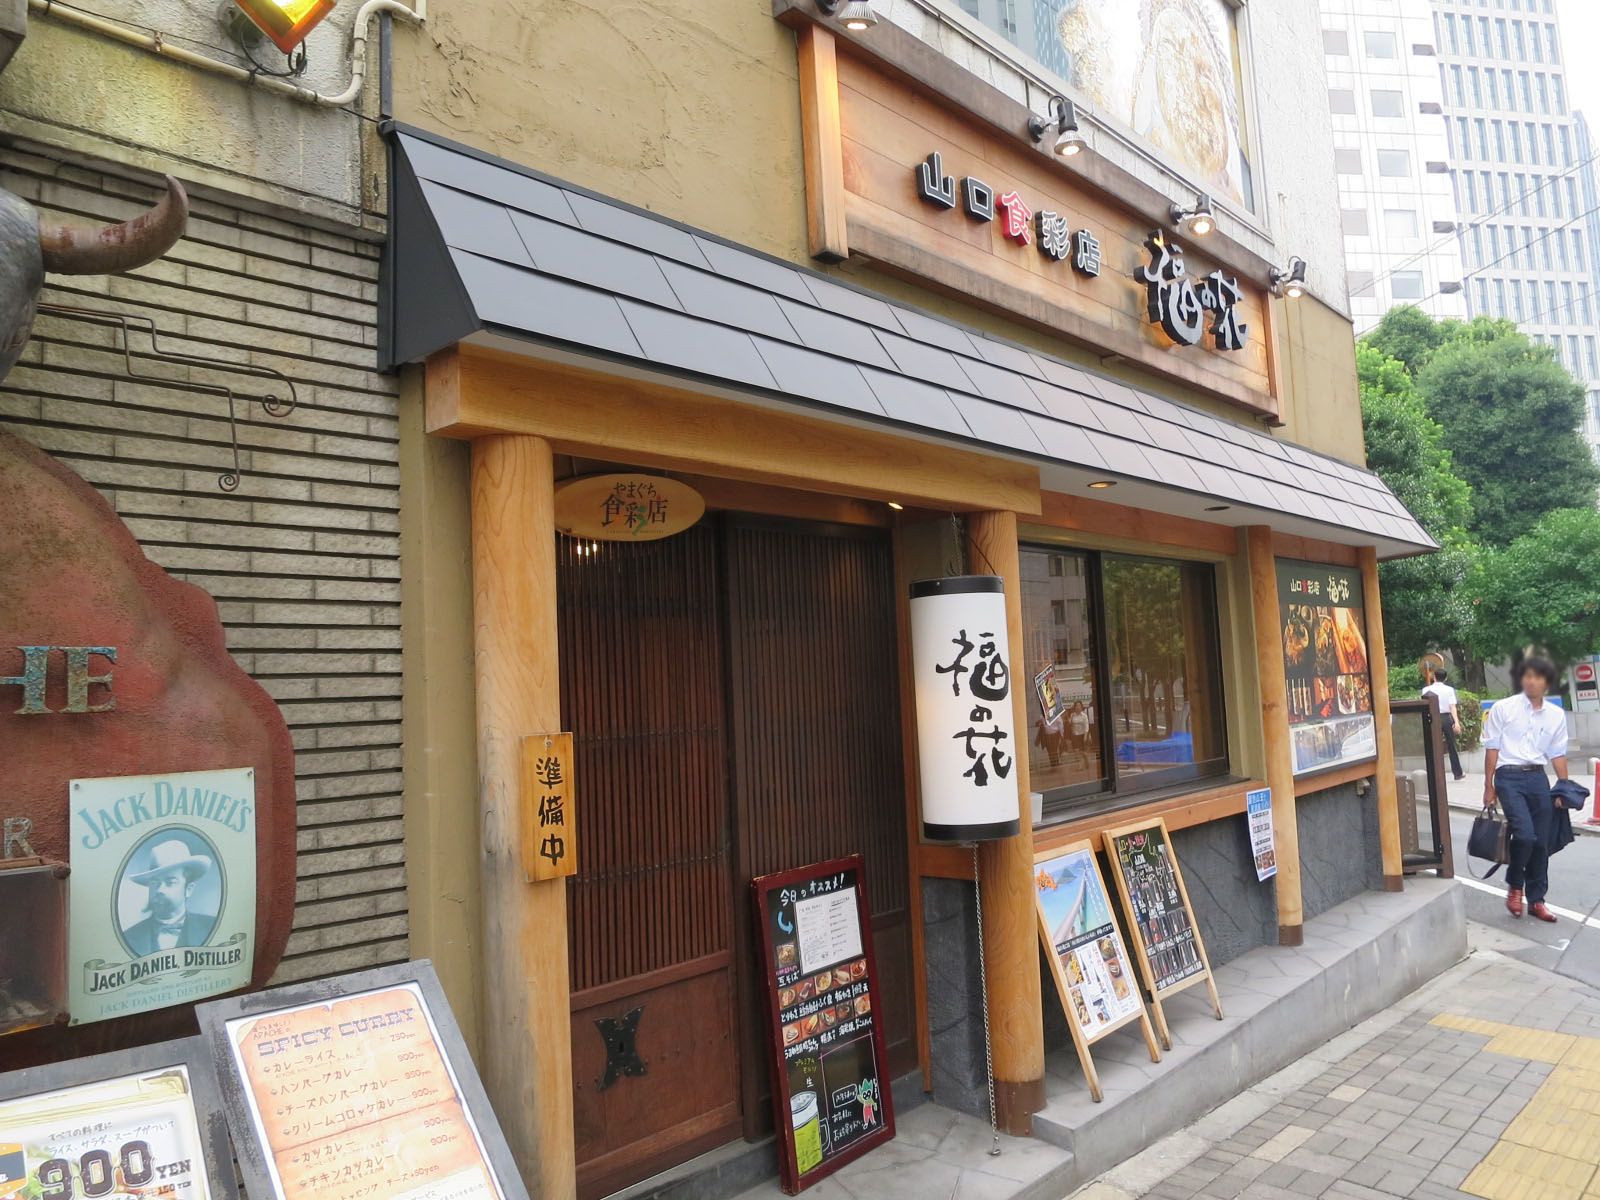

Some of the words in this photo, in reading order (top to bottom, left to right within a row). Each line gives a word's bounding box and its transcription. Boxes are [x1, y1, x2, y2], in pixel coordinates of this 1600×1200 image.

[916, 151, 1102, 277] 山口食彩店
[613, 481, 657, 499] やまぐち
[600, 494, 668, 528] 食彩店
[77, 792, 151, 849] JACK
[154, 781, 252, 832] DANIEL'S
[535, 756, 565, 867] 準備中
[90, 970, 126, 992] JACK
[184, 948, 242, 967] DISTILLER
[257, 1026, 333, 1056] SPICY
[338, 1008, 416, 1037] CURRY
[273, 1049, 336, 1073] カレーライス
[48, 1121, 113, 1141] すべての料理に
[292, 1095, 411, 1136] クリームコロッケカレー
[37, 1140, 154, 1200] 900
[155, 1159, 192, 1179] YEN
[301, 1141, 355, 1163] カツカレー
[308, 1154, 396, 1186] チキンカツカレー
